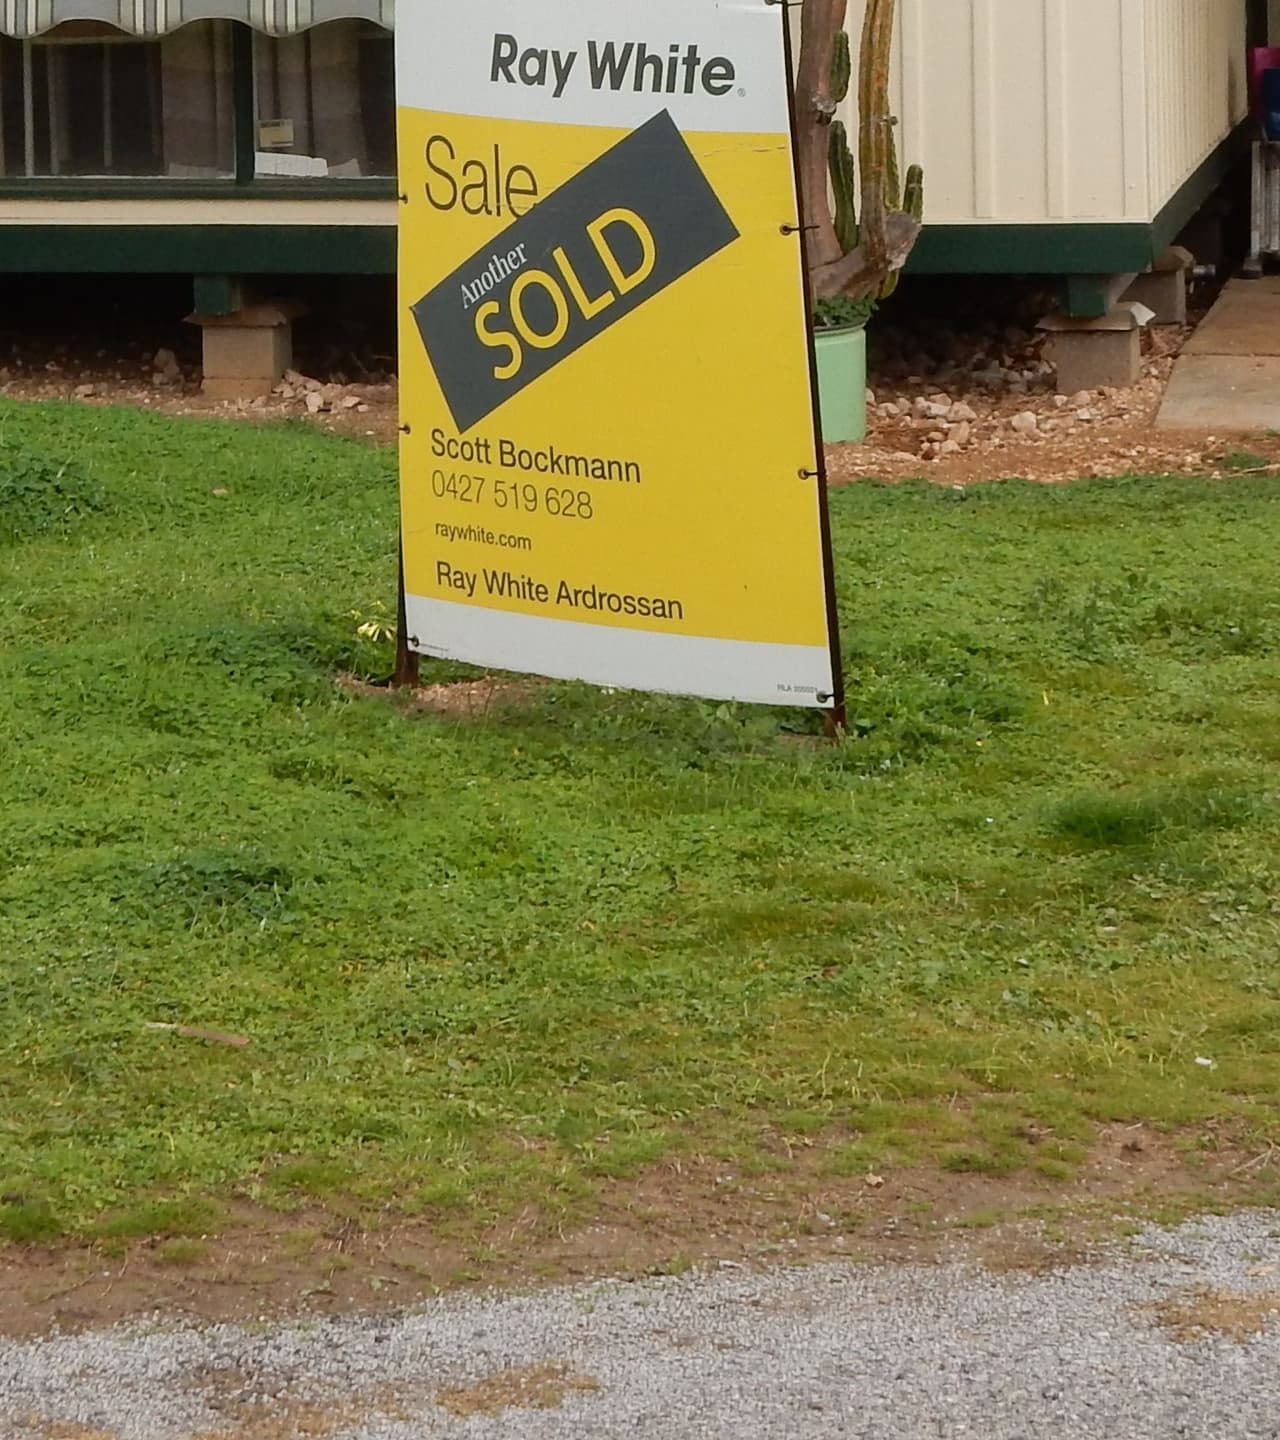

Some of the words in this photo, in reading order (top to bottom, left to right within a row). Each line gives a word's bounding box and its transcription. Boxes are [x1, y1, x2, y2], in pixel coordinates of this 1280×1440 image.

[490, 33, 578, 98] Ray
[587, 39, 736, 97] White
[424, 134, 538, 219] Sale
[457, 242, 529, 310] Another
[473, 207, 657, 381] SOLD
[431, 428, 492, 465] Scott
[499, 439, 641, 484] Bockmann
[431, 469, 485, 504] 0427
[494, 480, 538, 513] 519
[545, 487, 594, 520] 628
[435, 520, 532, 551] raywhite.com
[436, 561, 477, 598] Ray
[482, 568, 549, 603] White
[555, 580, 684, 620] Ardrossan
